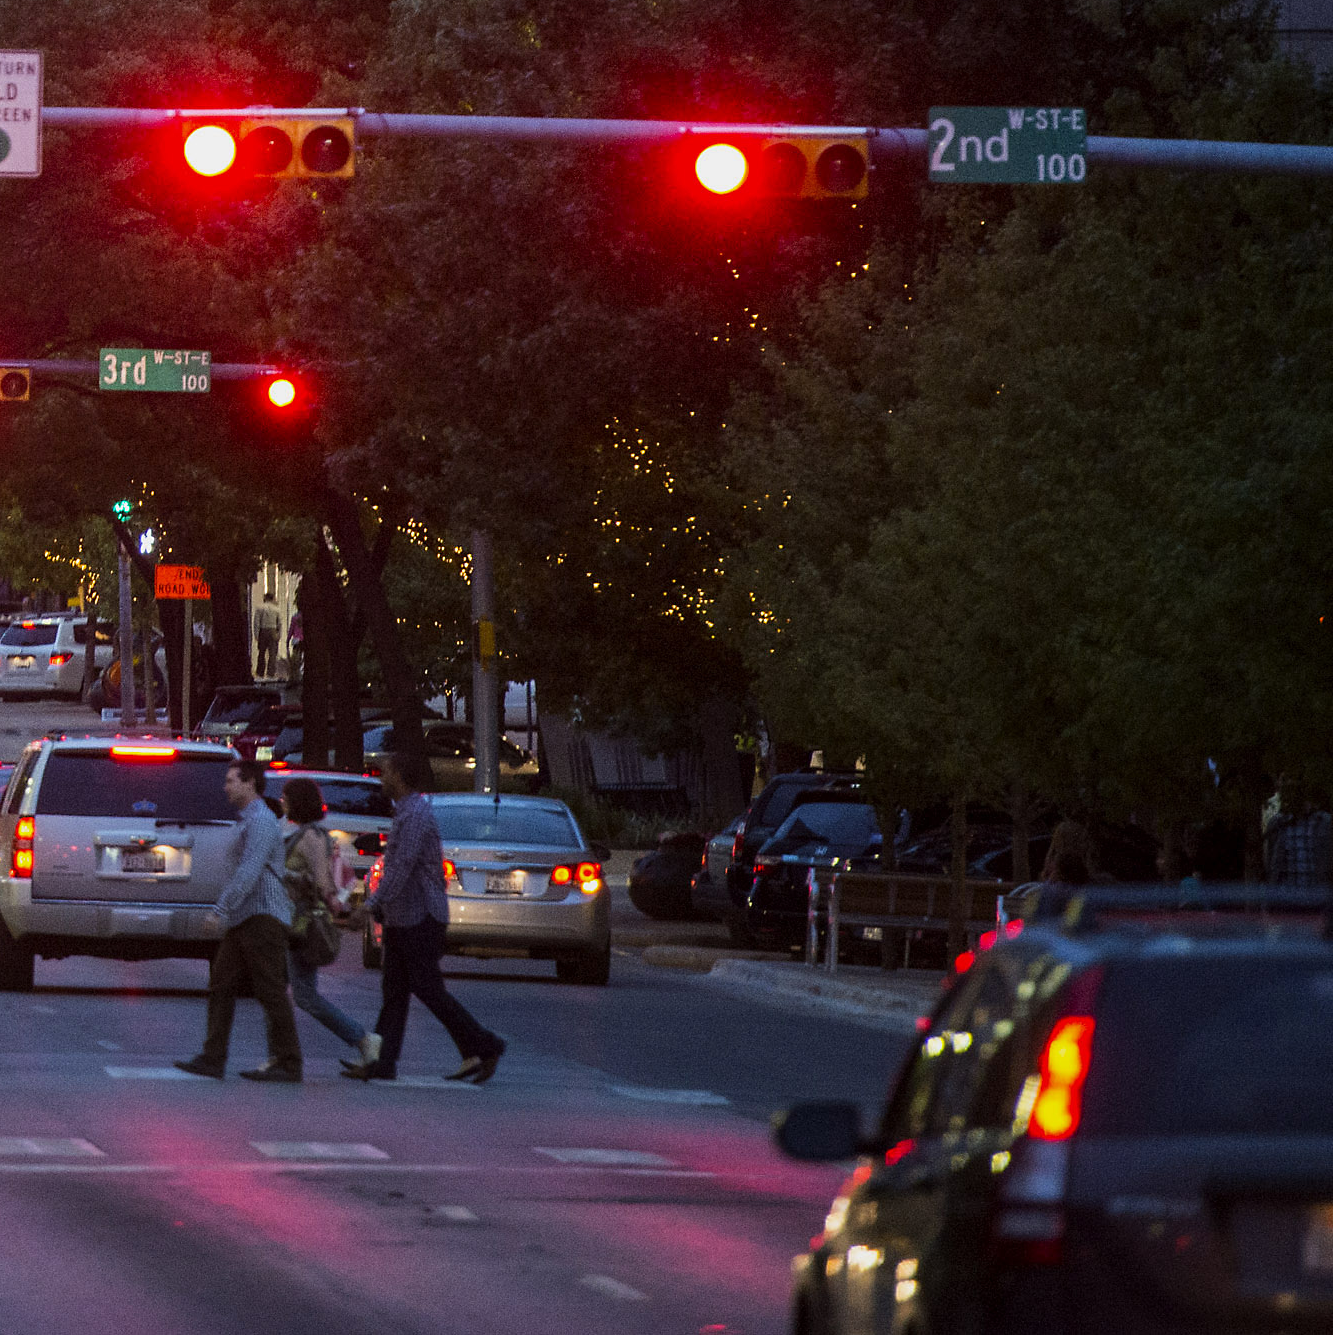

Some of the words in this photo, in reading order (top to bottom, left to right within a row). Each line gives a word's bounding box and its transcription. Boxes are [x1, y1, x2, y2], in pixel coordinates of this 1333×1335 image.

[930, 117, 1009, 172] 2nd
[1007, 108, 1084, 131] W-ST-E
[1036, 152, 1086, 182] 100
[103, 353, 147, 386] 3rd
[153, 349, 210, 365] W-ST-E
[181, 373, 208, 392] 100
[178, 568, 200, 580] END
[158, 583, 185, 595] ROAD
